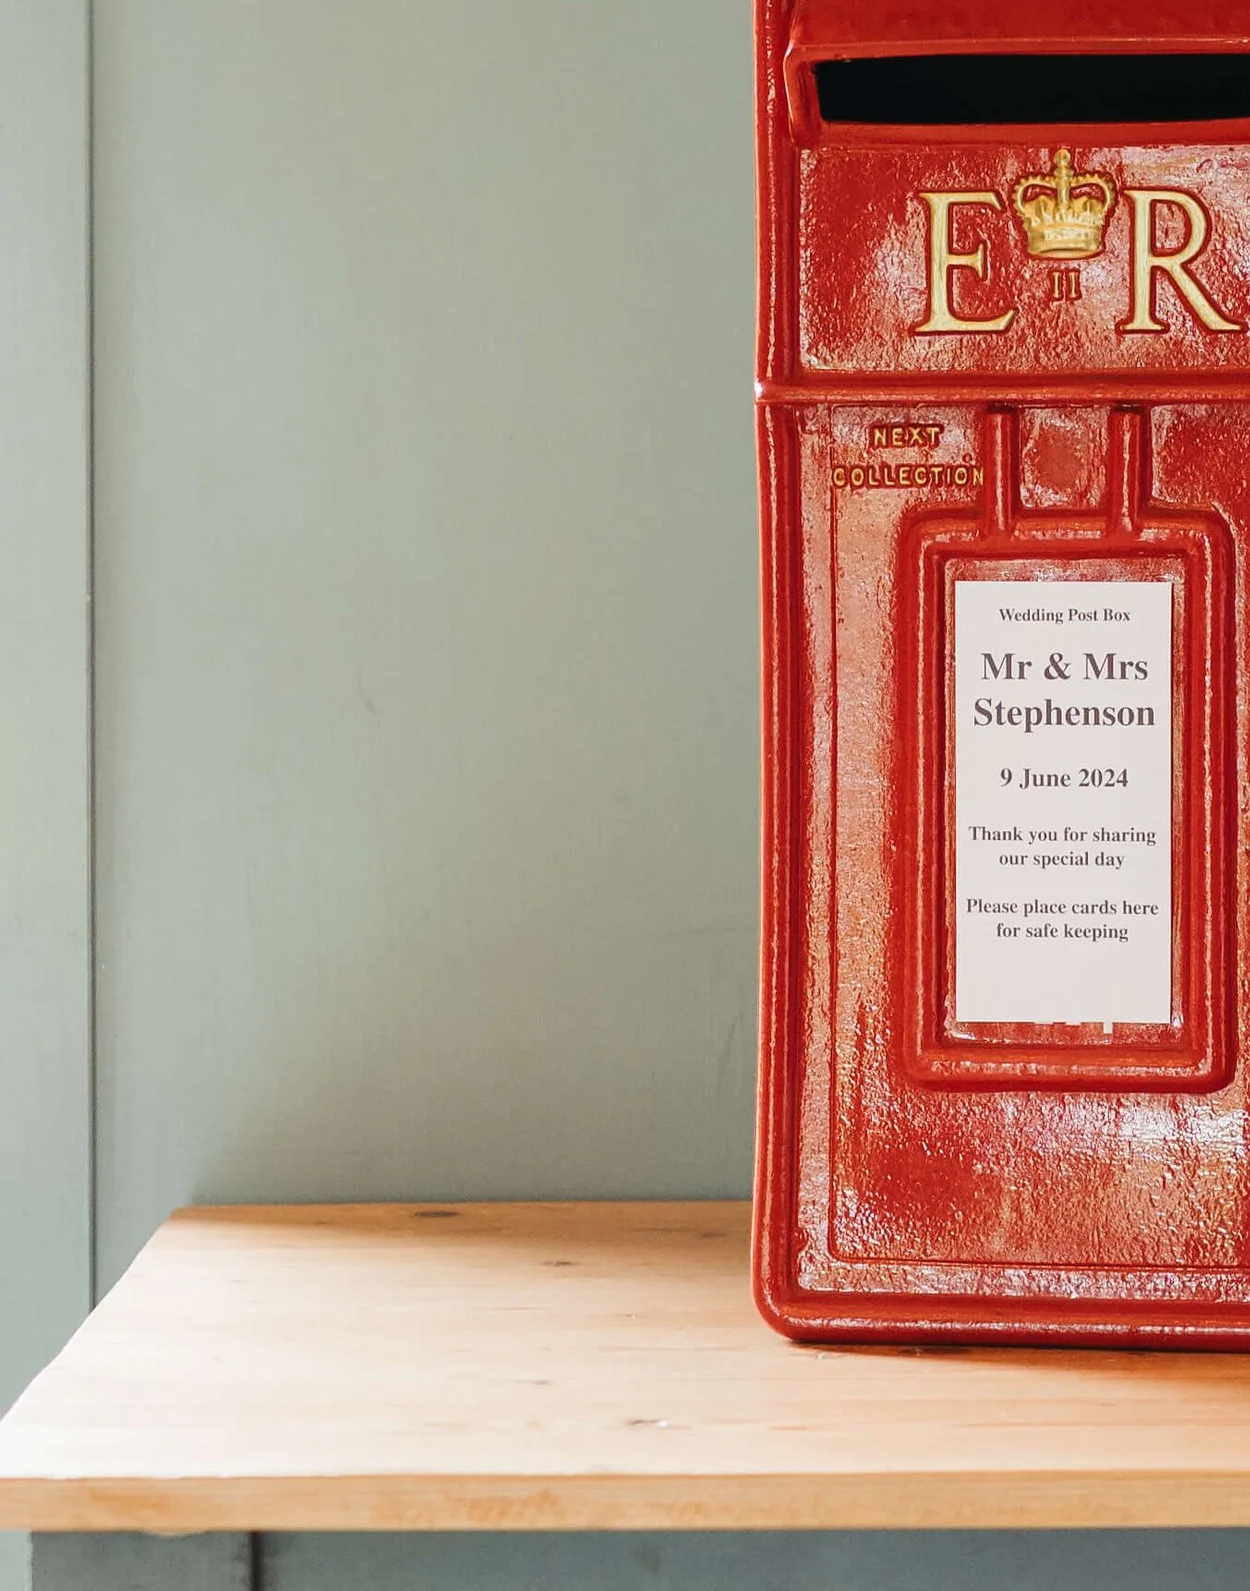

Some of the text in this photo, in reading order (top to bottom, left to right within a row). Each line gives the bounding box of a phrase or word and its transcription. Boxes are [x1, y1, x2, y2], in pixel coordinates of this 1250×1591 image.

[914, 189, 1242, 335] E R
[1049, 270, 1082, 301] II
[873, 427, 941, 446] NEXT
[833, 466, 984, 486] COLLECTION
[998, 608, 1131, 625] Wedding Post Box
[981, 652, 1149, 681] Mr & Mrs
[973, 697, 1155, 734] Stephenson
[1000, 768, 1129, 789] 9 June 2024
[968, 825, 1157, 847] Thank you for sharing
[999, 850, 1125, 870] our special day
[966, 898, 1159, 918] Please place cards here
[996, 922, 1129, 943] for safe keeping
